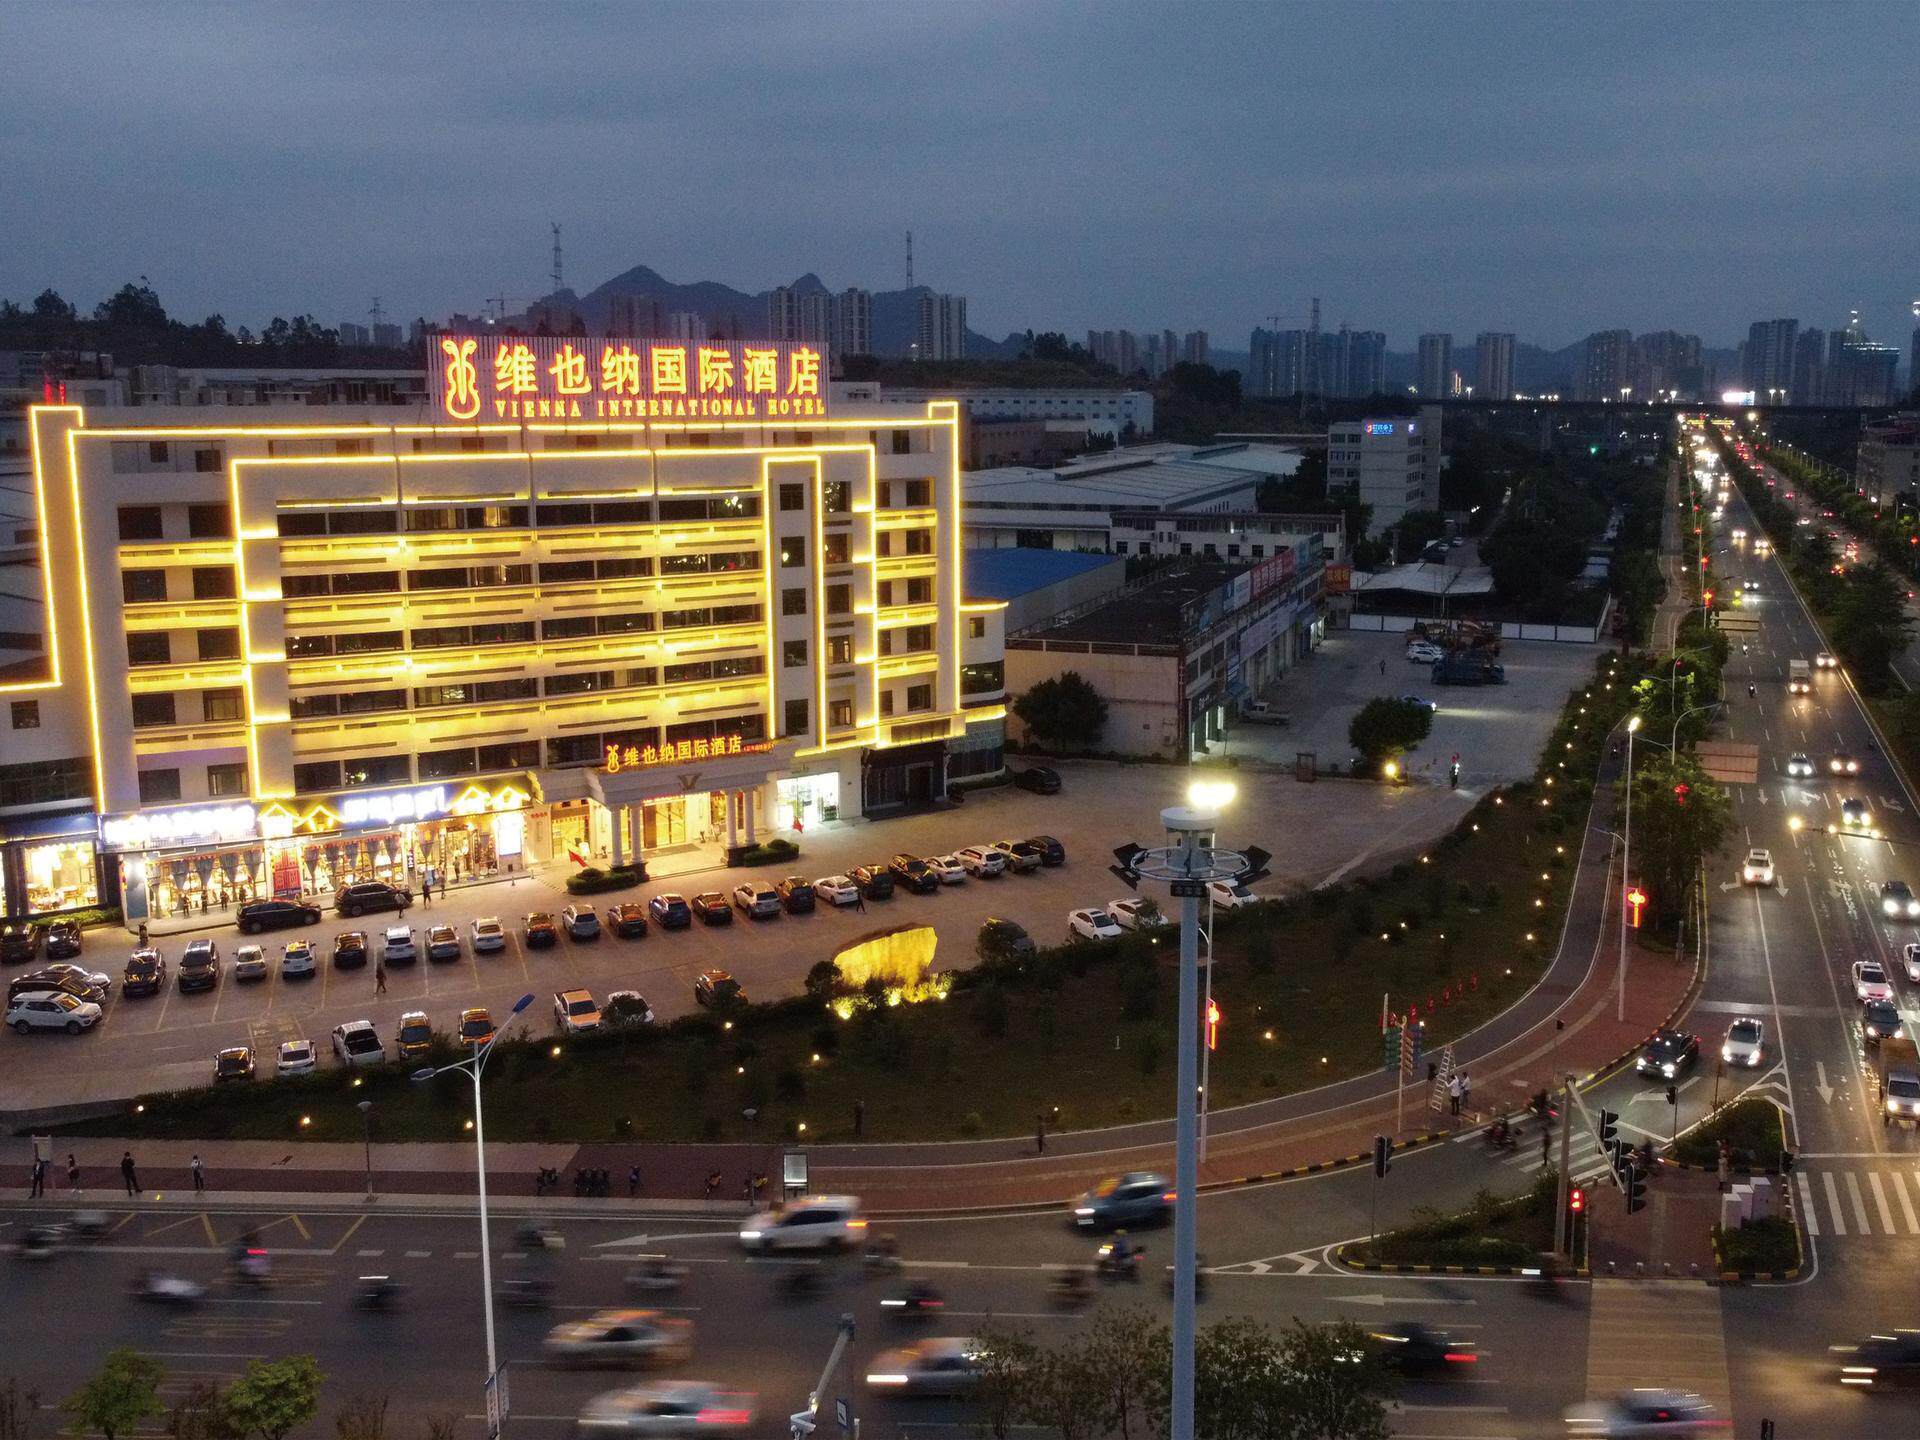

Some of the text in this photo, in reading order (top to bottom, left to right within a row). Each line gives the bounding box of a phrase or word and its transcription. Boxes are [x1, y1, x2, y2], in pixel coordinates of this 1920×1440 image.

[495, 345, 820, 395] 维也纳国际酒店
[495, 398, 825, 418] VIENNA INTERNATIONAL HOTEL
[625, 735, 742, 766] 维也纳国际酒店
